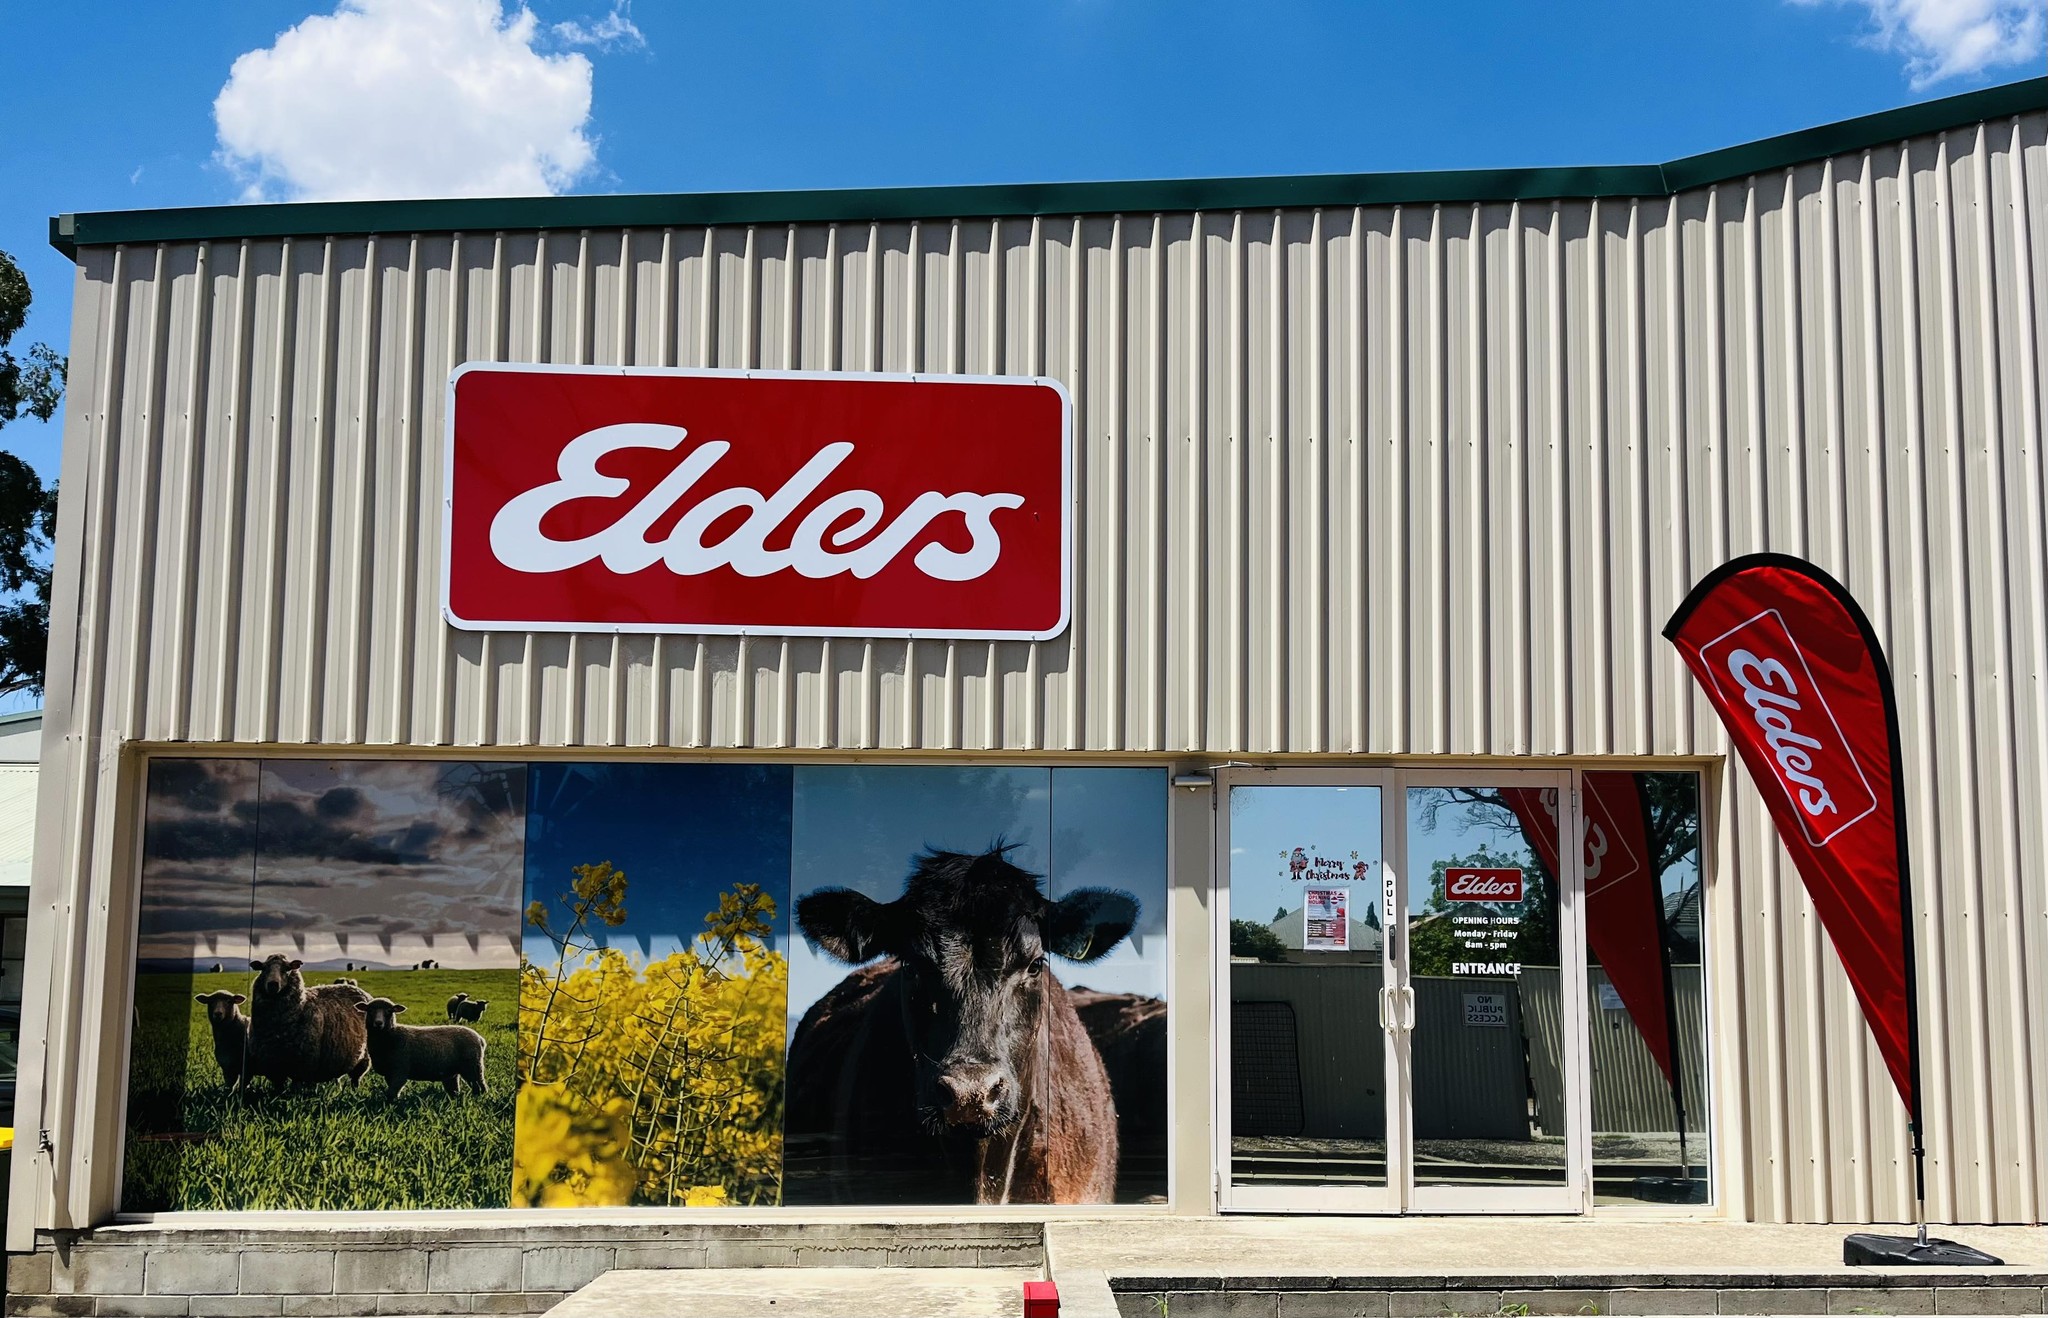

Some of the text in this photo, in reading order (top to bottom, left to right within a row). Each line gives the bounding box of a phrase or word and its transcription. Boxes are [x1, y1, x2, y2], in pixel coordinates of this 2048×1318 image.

[489, 422, 1025, 581] Elders
[1727, 648, 1838, 816] Elders
[1314, 857, 1344, 871] Merry
[1305, 869, 1350, 880] Christmas
[1451, 874, 1517, 895] Elders
[1452, 917, 1520, 925] OPENING HOURS
[1454, 930, 1487, 939] Monday
[1493, 930, 1518, 939] Friday
[1465, 941, 1483, 949] 8am
[1489, 942, 1507, 950] 5pm
[1452, 962, 1522, 975] ENTRANCE
